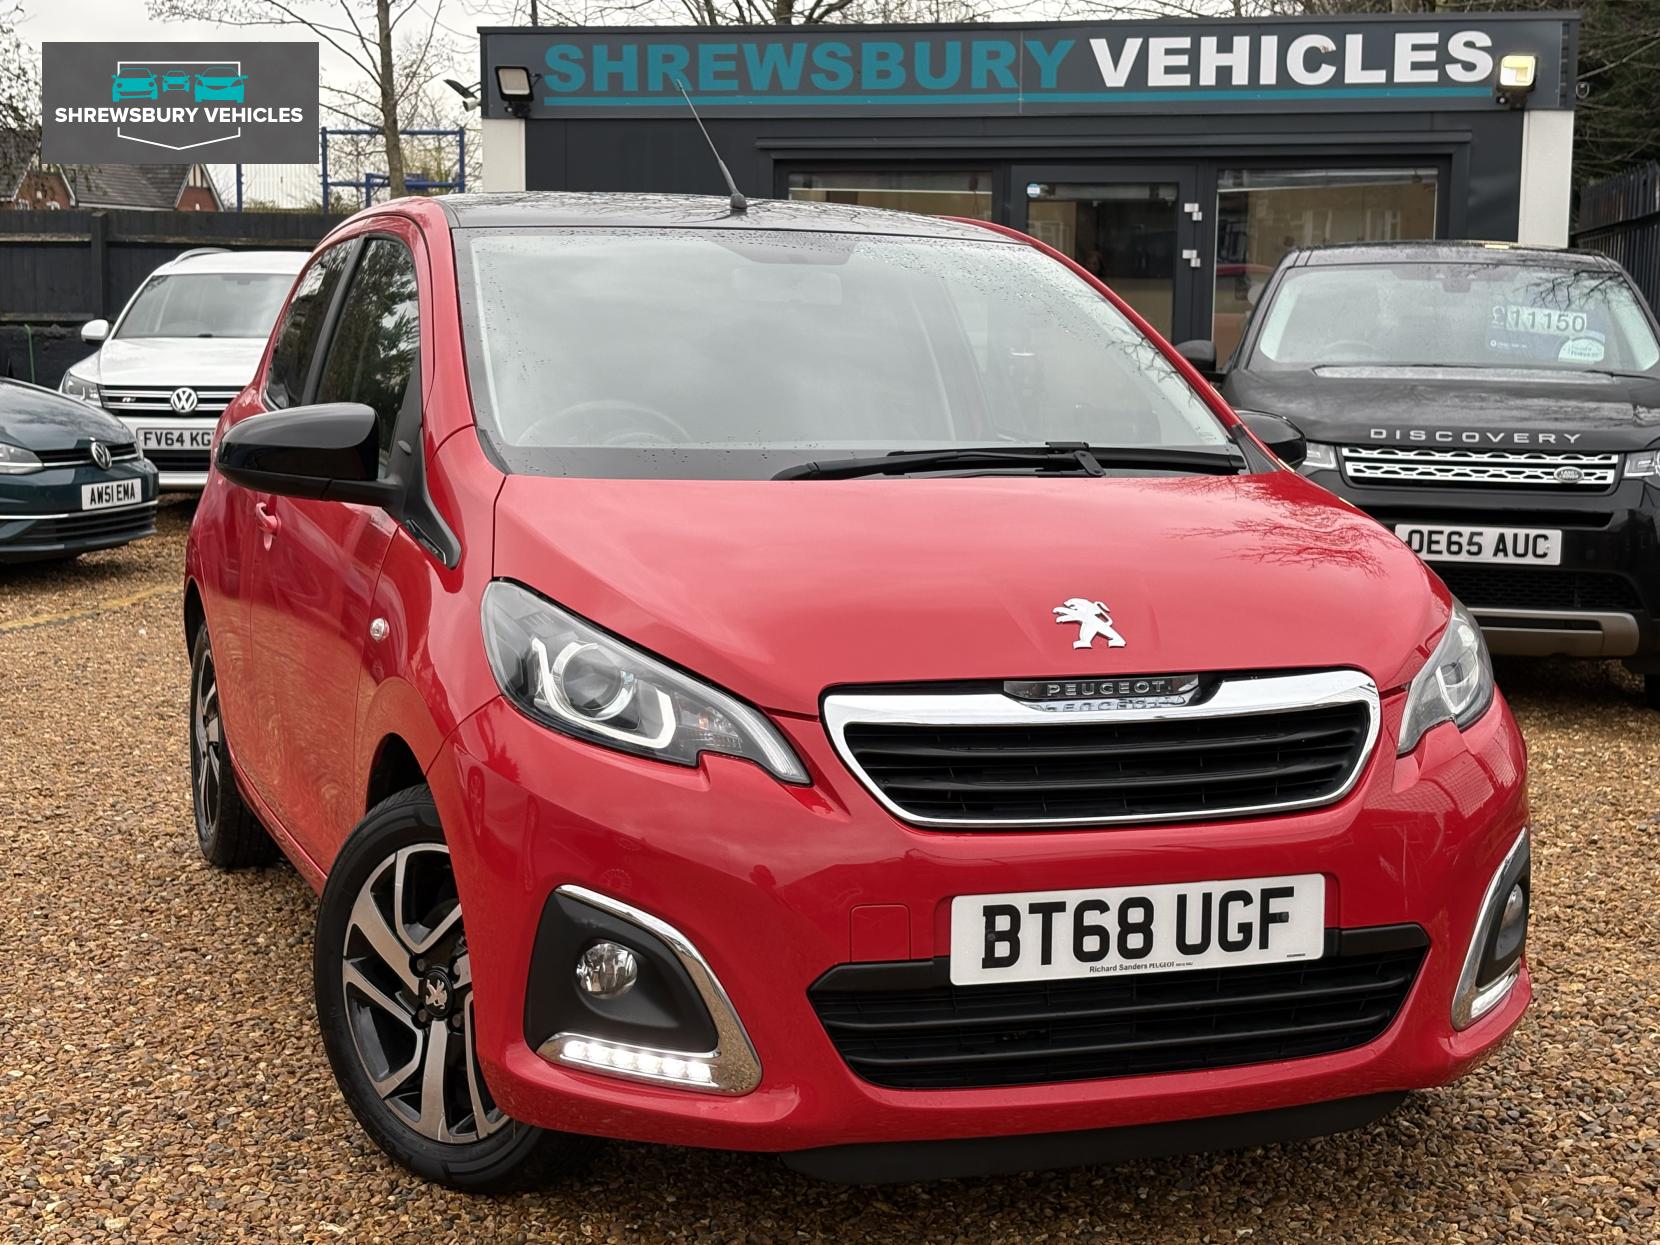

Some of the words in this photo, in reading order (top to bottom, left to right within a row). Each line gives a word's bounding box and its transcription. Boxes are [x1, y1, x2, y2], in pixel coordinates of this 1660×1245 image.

[543, 39, 1076, 92] SHREWSBURY
[1089, 30, 1494, 88] VEHICLES
[143, 431, 185, 447] FV64
[190, 431, 215, 447] KG
[1370, 428, 1582, 444] DISCOVERY
[116, 482, 136, 502] EMA
[1406, 529, 1484, 556] OE65
[1492, 532, 1550, 559] AUC
[1047, 680, 1165, 697] PEUGEOT
[981, 896, 1155, 970] BT68
[1175, 886, 1295, 956] UGF
[1089, 964, 1118, 974] Richard
[1118, 962, 1148, 972] Sanders
[1148, 961, 1175, 970] PEUGEOT
